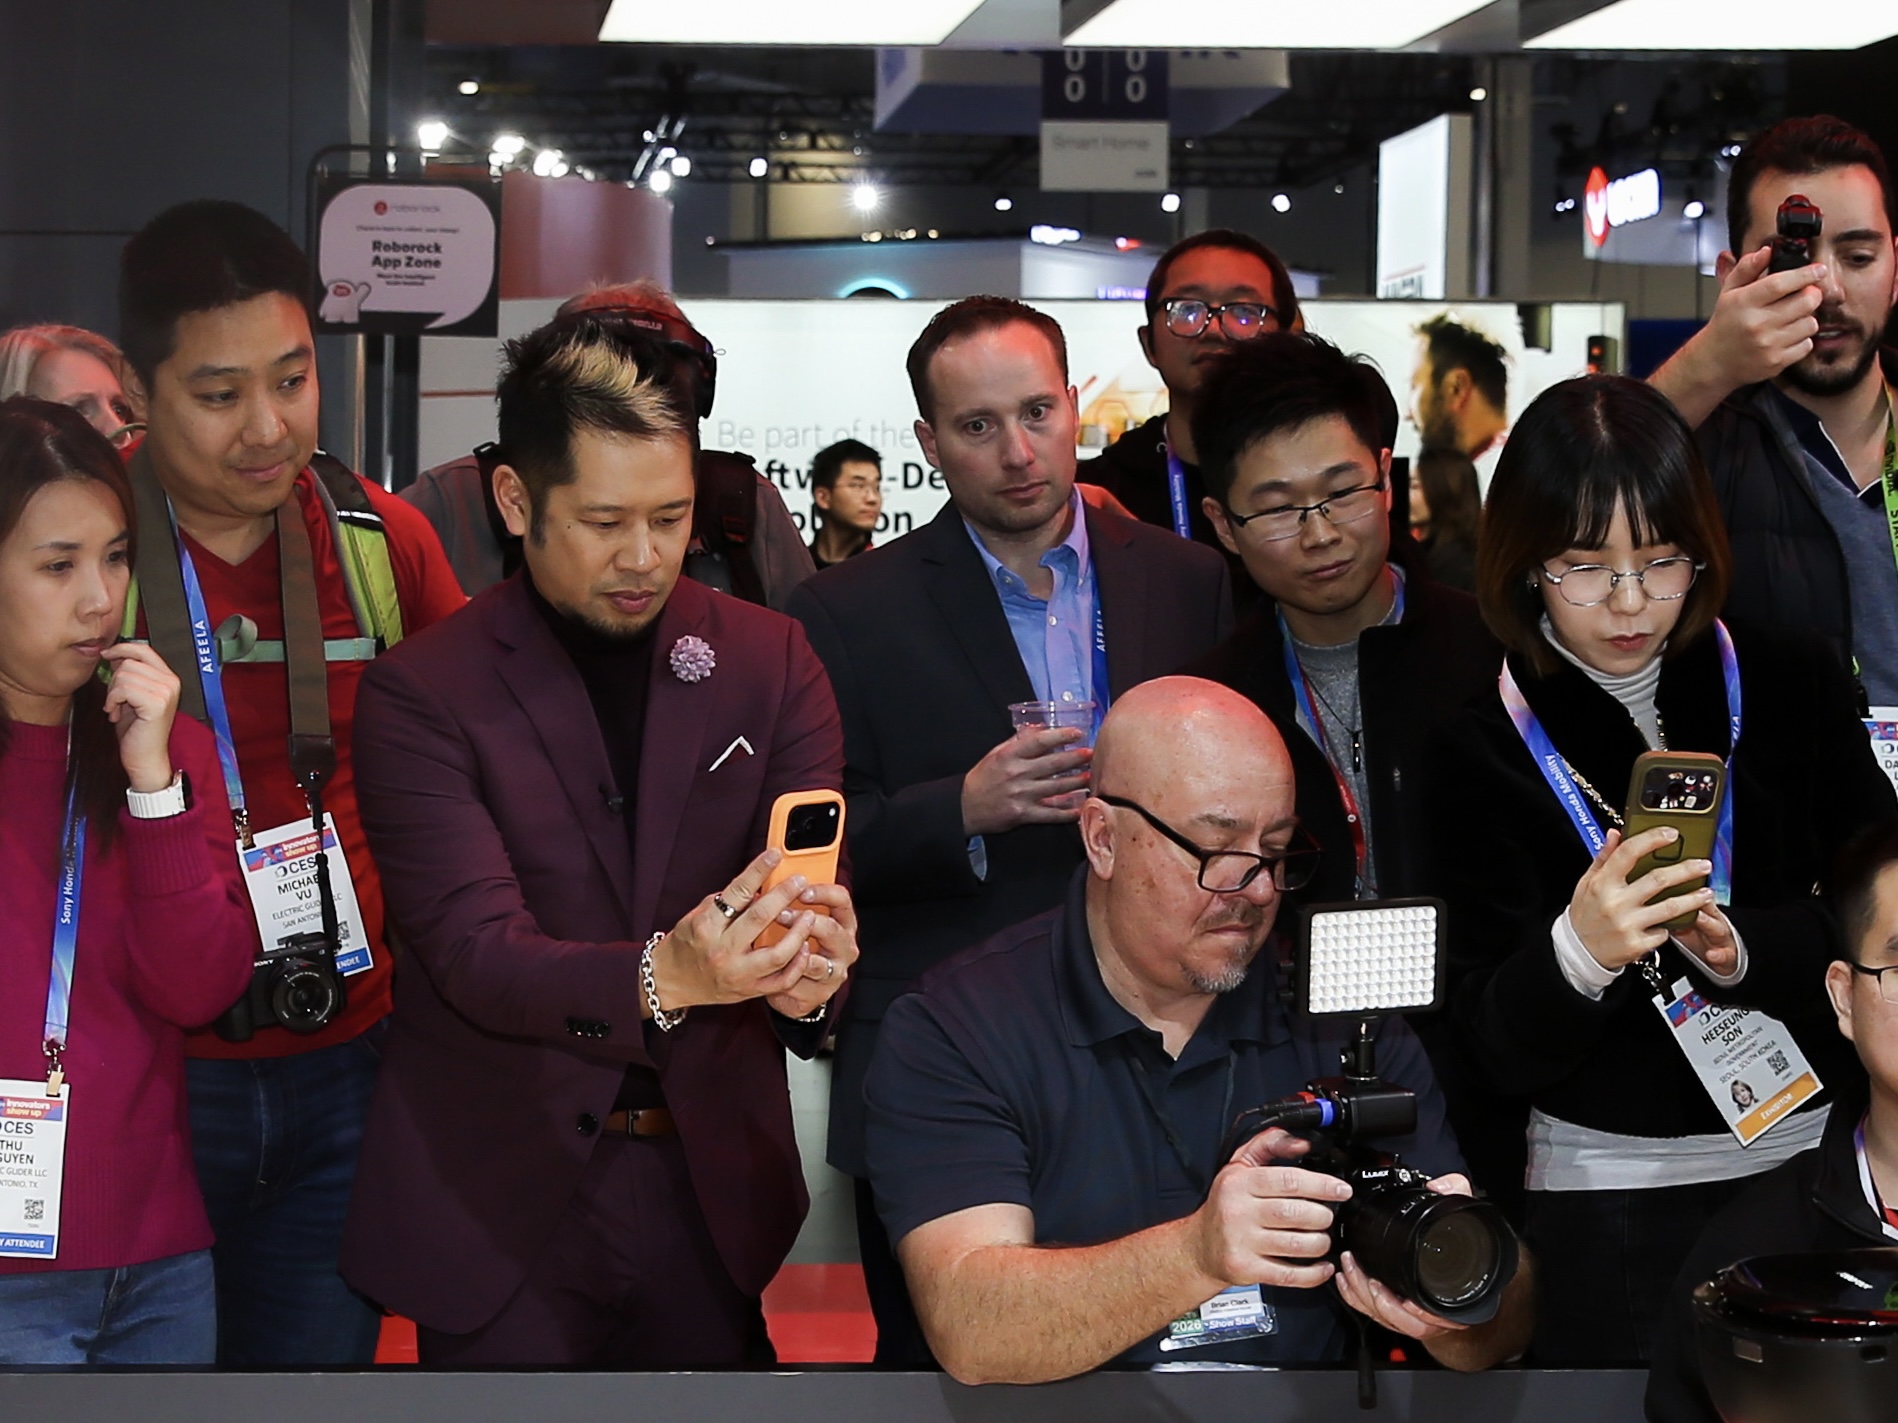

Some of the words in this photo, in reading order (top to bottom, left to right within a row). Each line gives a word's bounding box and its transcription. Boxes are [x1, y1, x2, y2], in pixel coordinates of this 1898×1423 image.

[1052, 136, 1099, 150] Smart
[1102, 134, 1149, 149] Home
[371, 240, 443, 254] Roborock
[371, 256, 402, 270] App
[405, 256, 442, 269] Zone
[717, 420, 755, 448] Be
[765, 422, 828, 453] part
[864, 419, 915, 449] the
[195, 620, 214, 673] AFEELA
[1545, 753, 1572, 793] Mobility
[1569, 792, 1591, 827] Honda
[1585, 826, 1604, 851] Sony
[289, 858, 317, 874] CES
[278, 874, 319, 895] MICHAE
[296, 890, 312, 901] VU
[61, 896, 76, 925] Sony
[272, 902, 305, 920] ELECTRIC
[282, 918, 297, 929] SAN
[297, 911, 322, 925] ANTONI
[1721, 1025, 1744, 1047] SON
[1758, 1040, 1777, 1058] KOREA
[6, 1099, 51, 1110] innovators
[6, 1108, 30, 1116] show
[30, 1108, 42, 1118] up
[4, 1121, 35, 1135] CES
[6, 1168, 33, 1177] GLIDER
[34, 1169, 48, 1178] LLC
[29, 1180, 38, 1189] TX
[5, 1239, 46, 1249] ATTENDEE
[1210, 1299, 1230, 1309] Brian
[1230, 1297, 1250, 1307] Clark
[1172, 1320, 1202, 1333] 2026
[1208, 1318, 1234, 1330] Show
[1235, 1316, 1257, 1328] Staff
